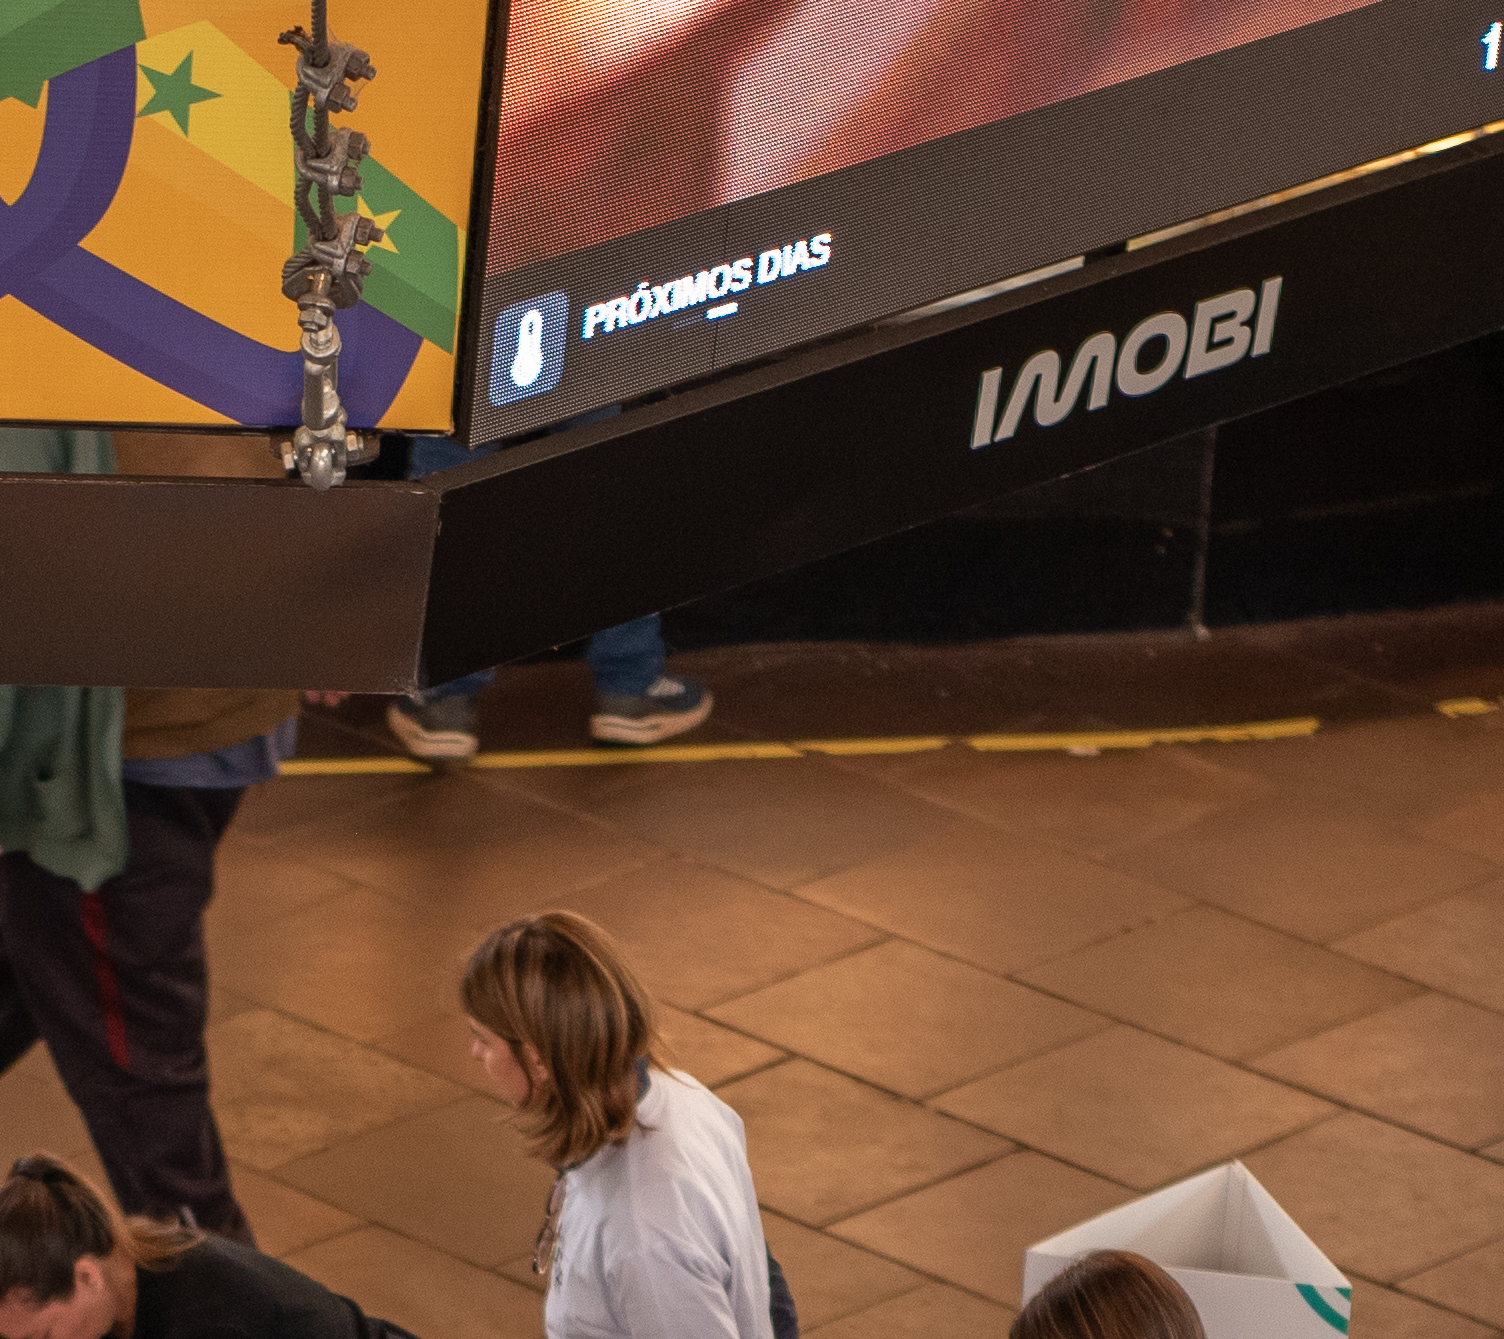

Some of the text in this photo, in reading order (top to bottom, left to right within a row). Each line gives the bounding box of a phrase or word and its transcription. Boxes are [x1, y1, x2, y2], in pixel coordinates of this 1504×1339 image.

[582, 232, 833, 340] PRÓXIMOS DIAS
[968, 276, 1283, 450] IMOBI
